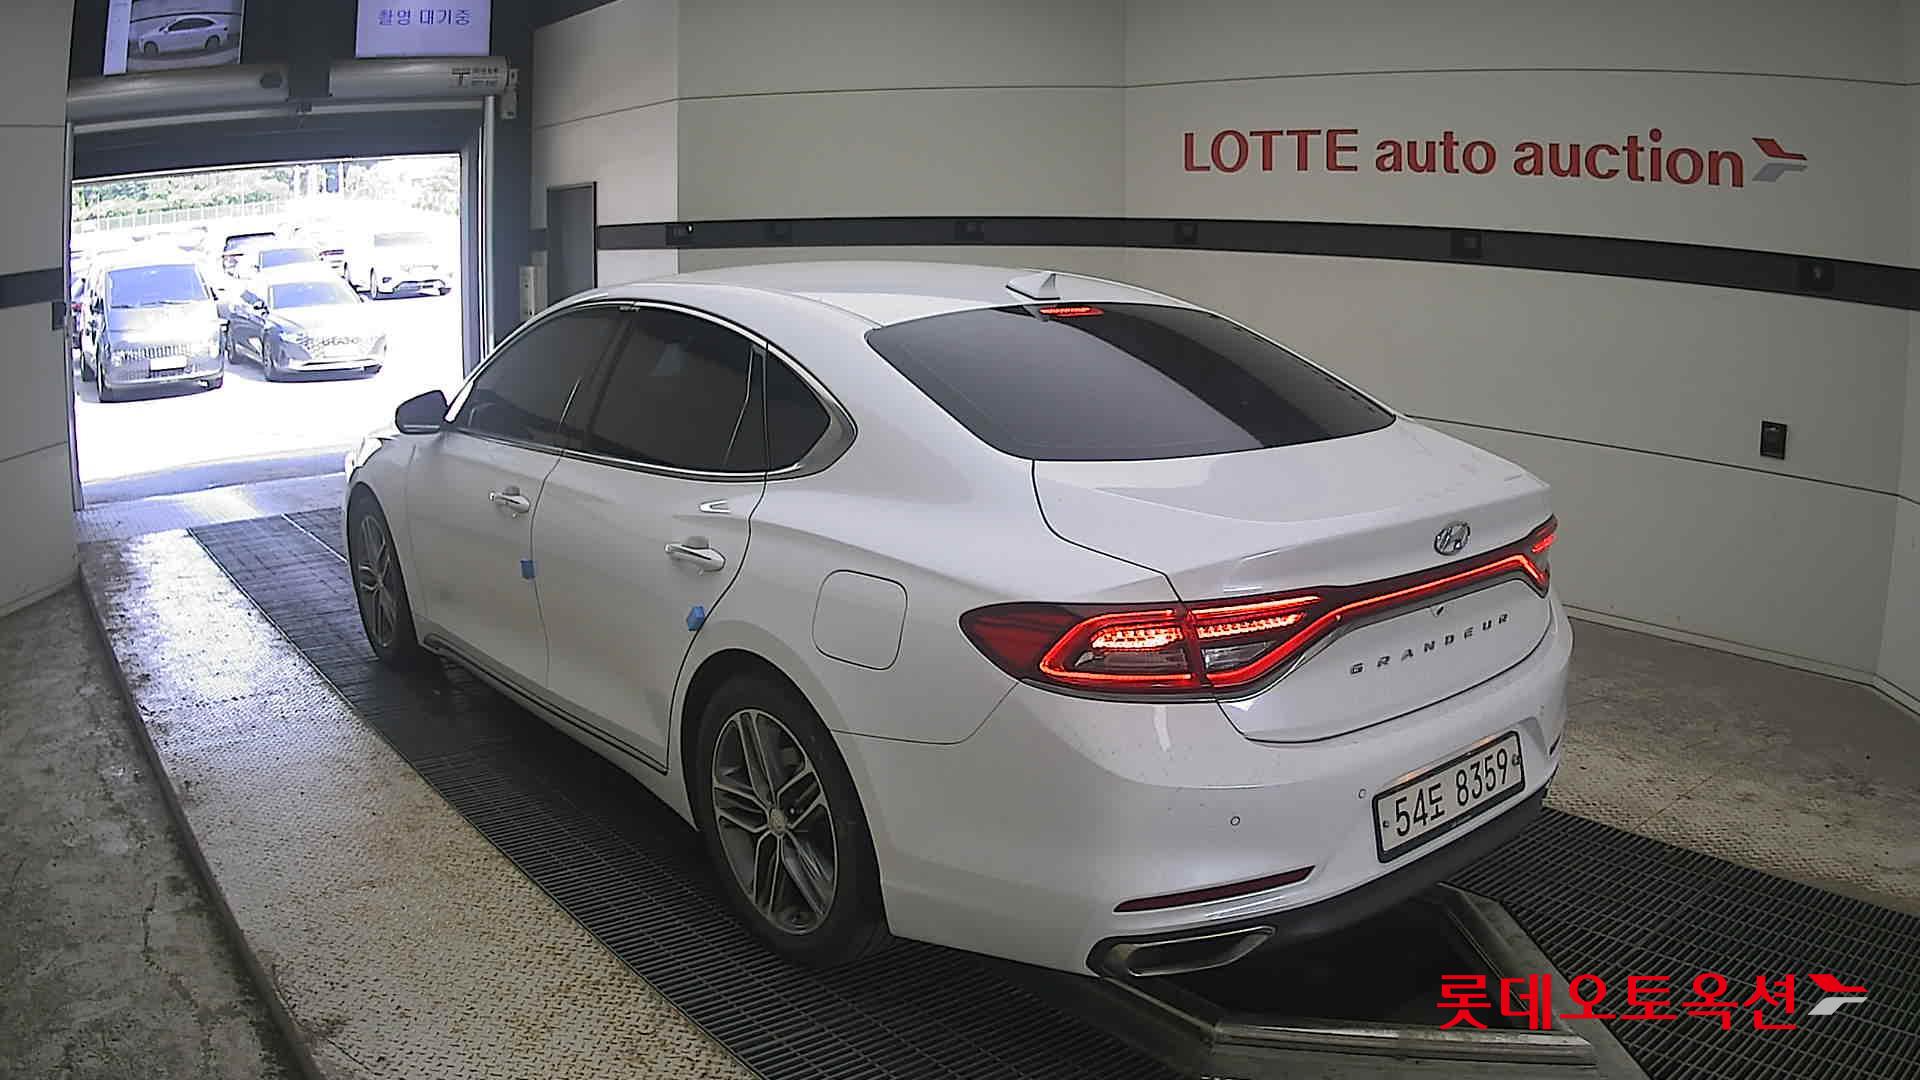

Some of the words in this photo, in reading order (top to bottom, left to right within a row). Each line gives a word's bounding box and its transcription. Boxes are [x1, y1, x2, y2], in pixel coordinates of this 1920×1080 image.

[378, 8, 411, 26] 촬영
[419, 8, 471, 26] 대기중
[1184, 129, 1358, 172] LOTTE
[1375, 130, 1496, 175] auto
[1513, 128, 1744, 187] auction
[1350, 613, 1509, 674] GRANDEUR
[1395, 783, 1445, 837] 54도
[1455, 748, 1508, 807] 8359
